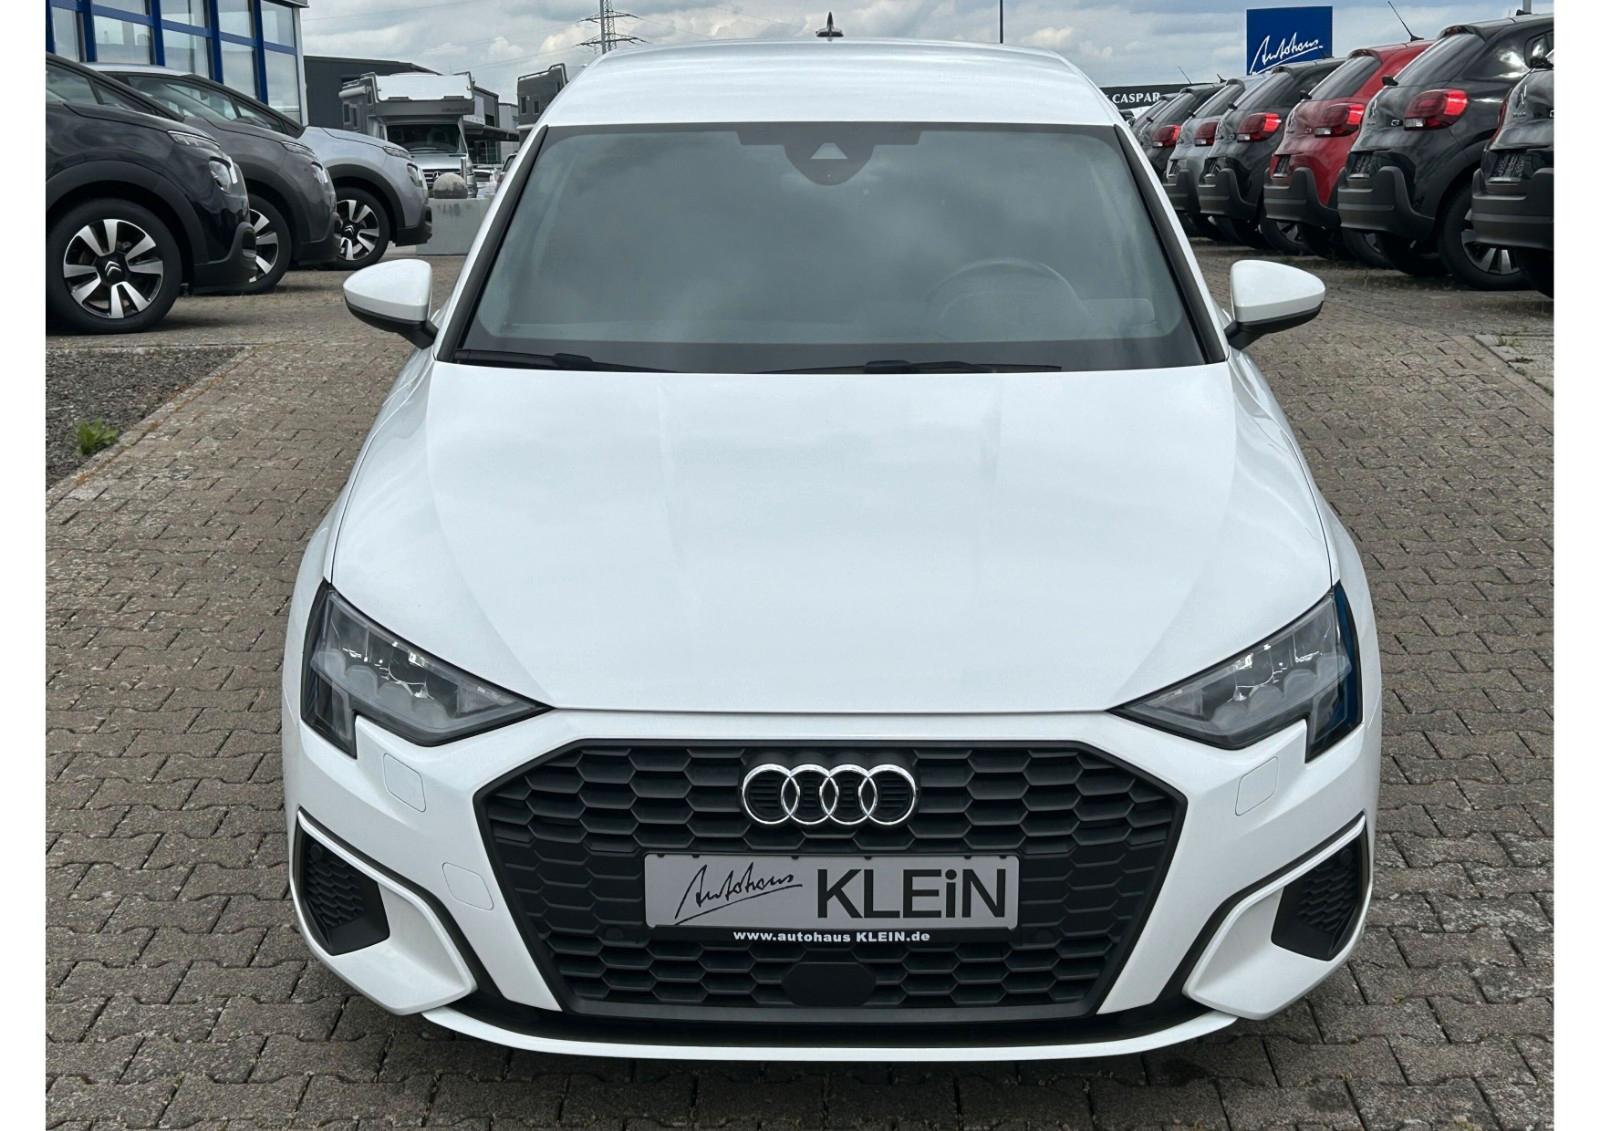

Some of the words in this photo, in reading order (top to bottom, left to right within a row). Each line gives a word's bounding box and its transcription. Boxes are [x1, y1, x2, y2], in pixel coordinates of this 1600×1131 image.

[1249, 32, 1320, 74] Autohaus
[1111, 91, 1161, 104] CASPAR
[674, 862, 798, 921] Autohaus
[733, 931, 850, 943] www.autohaus
[856, 931, 931, 943] KLEIN.de
